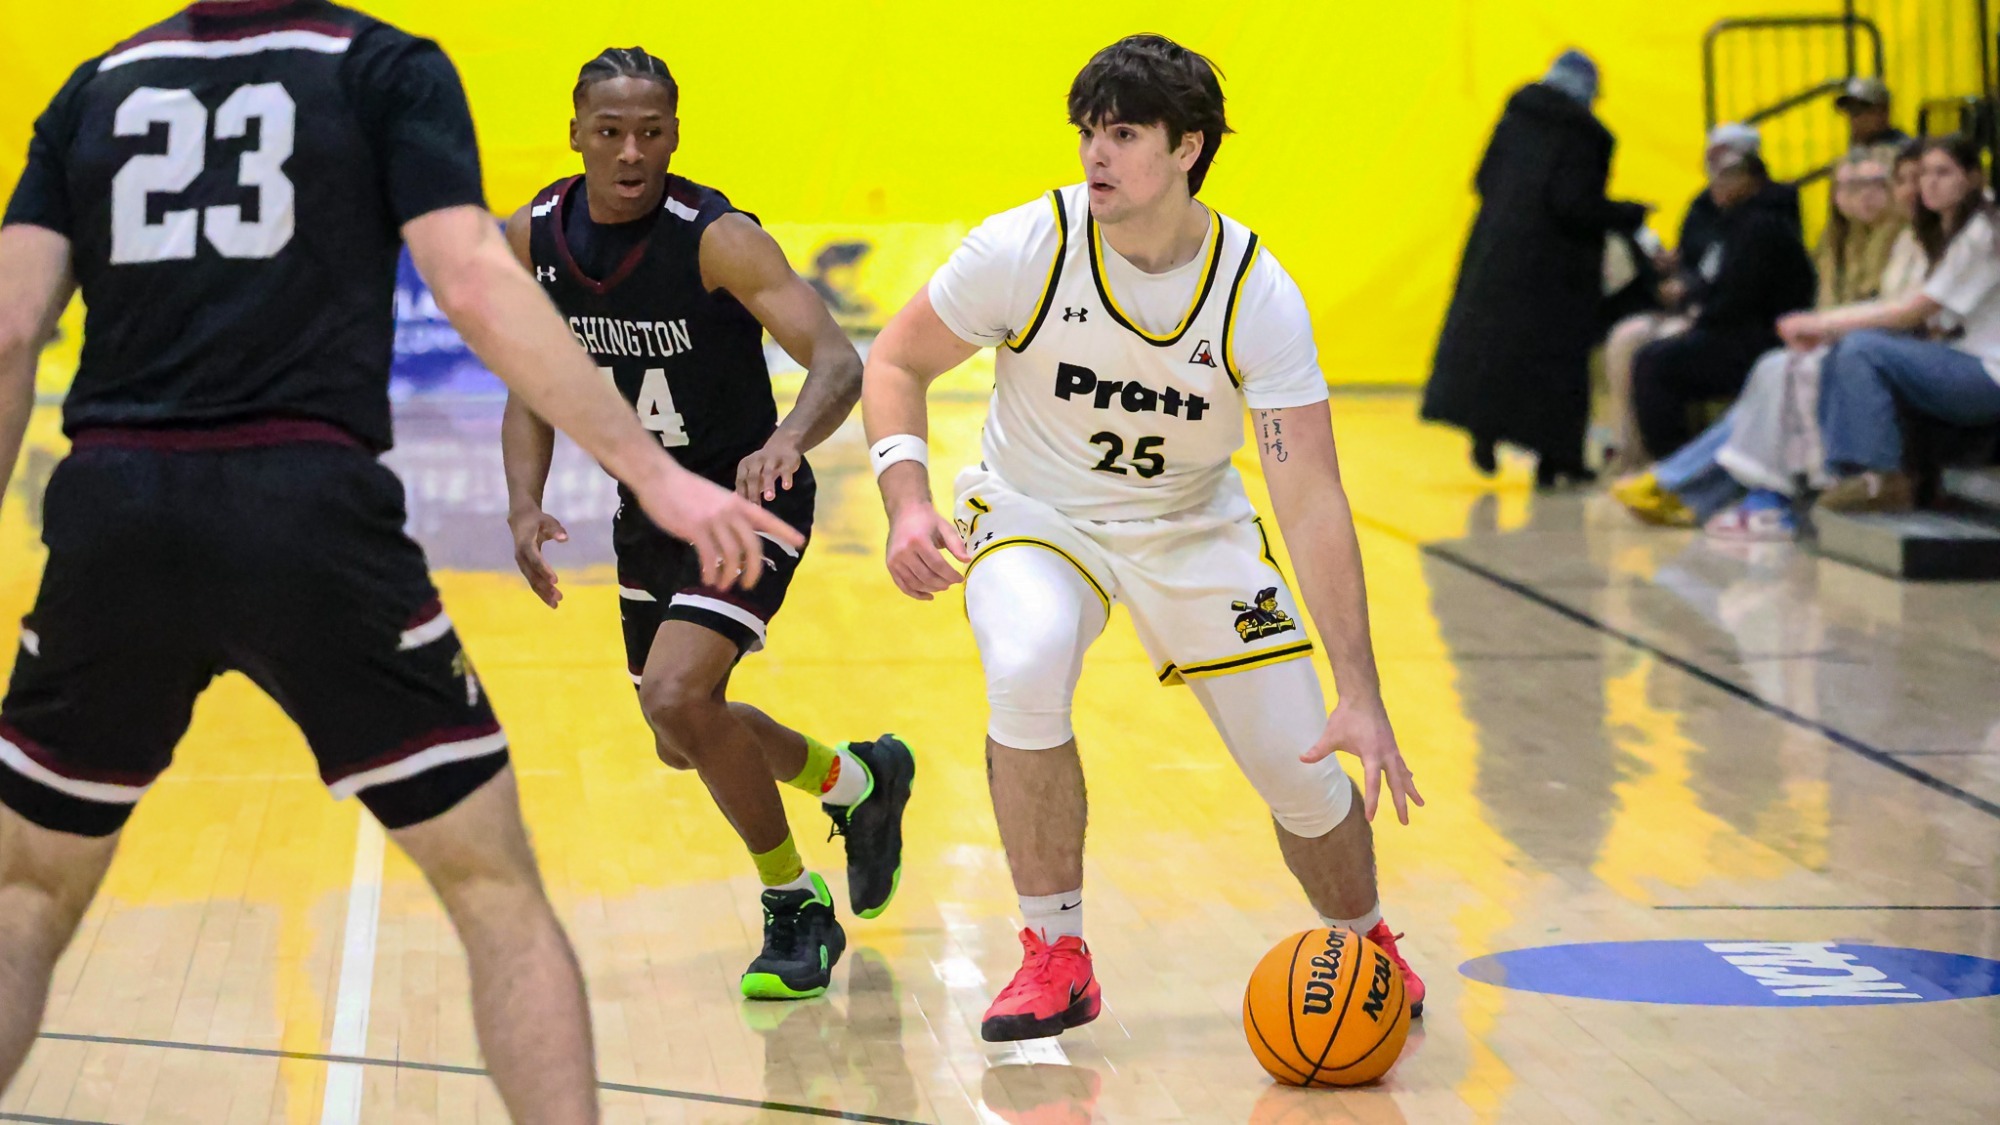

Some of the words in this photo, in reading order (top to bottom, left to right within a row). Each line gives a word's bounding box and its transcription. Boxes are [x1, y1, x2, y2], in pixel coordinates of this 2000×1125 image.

[110, 82, 296, 264] 23
[569, 316, 693, 357] SHINGTON
[1055, 362, 1210, 420] Pratt
[1089, 431, 1165, 478] 25
[1303, 930, 1347, 1015] Wilson
[1362, 952, 1391, 1022] NCAA
[1703, 941, 1924, 999] NCAA
